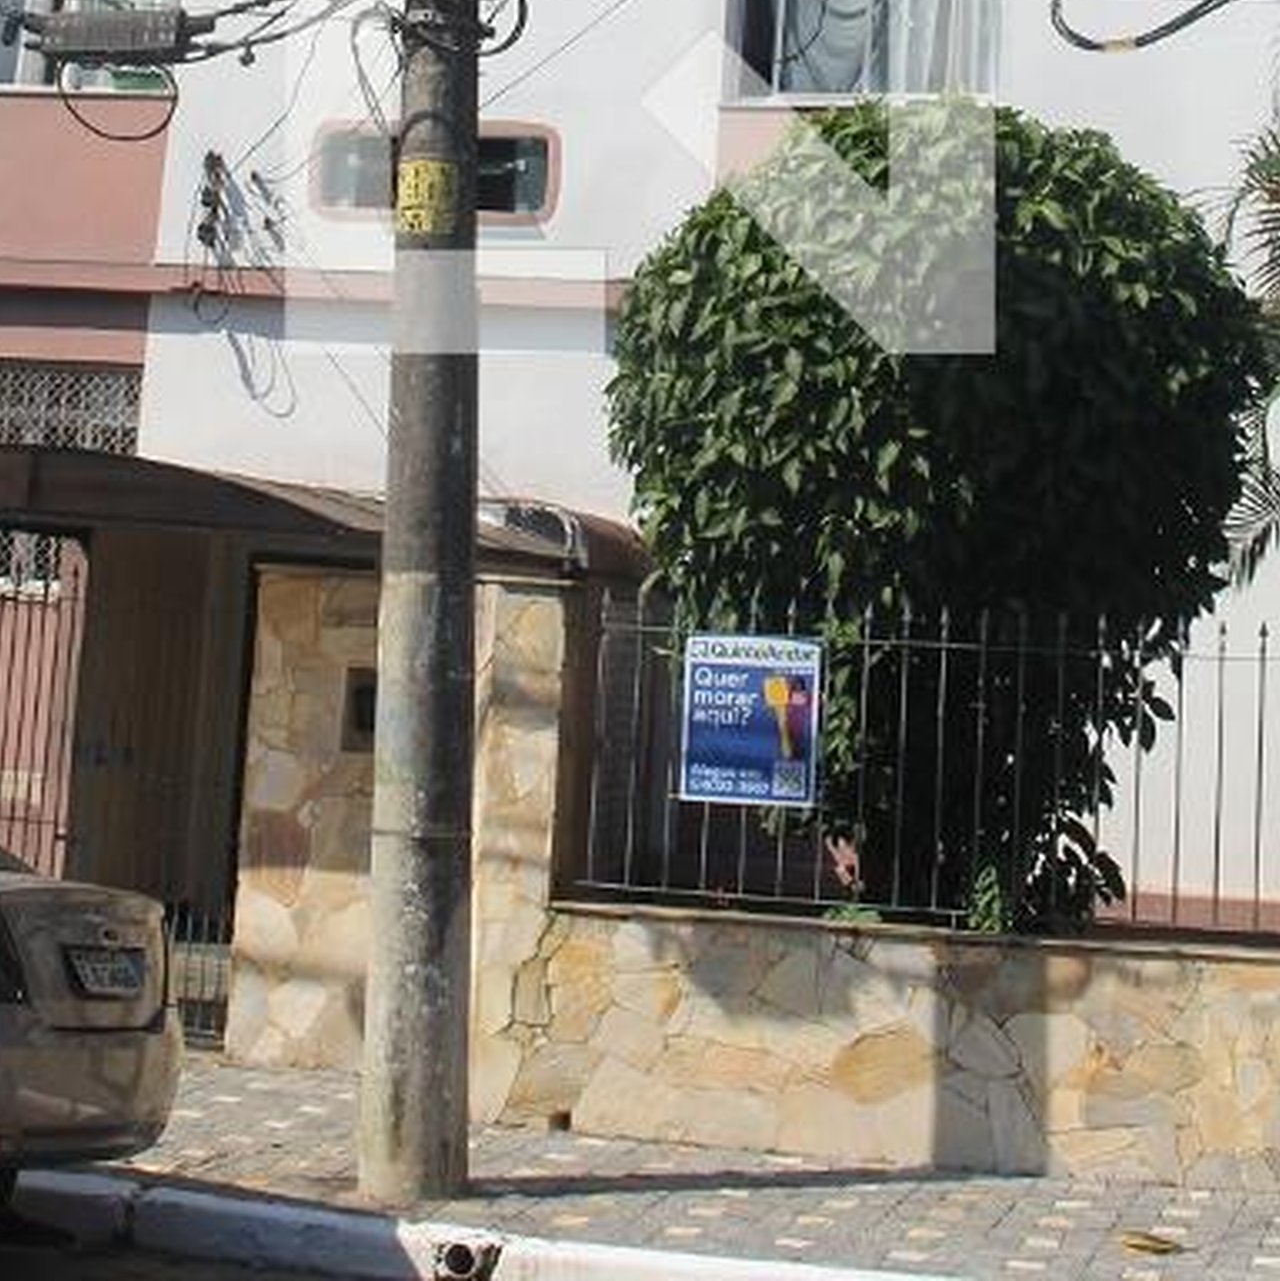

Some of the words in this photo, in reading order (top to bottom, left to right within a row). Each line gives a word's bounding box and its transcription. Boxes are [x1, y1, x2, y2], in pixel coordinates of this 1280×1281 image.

[695, 666, 749, 688] Quer
[695, 690, 759, 706] morar
[693, 706, 752, 727] aqui?
